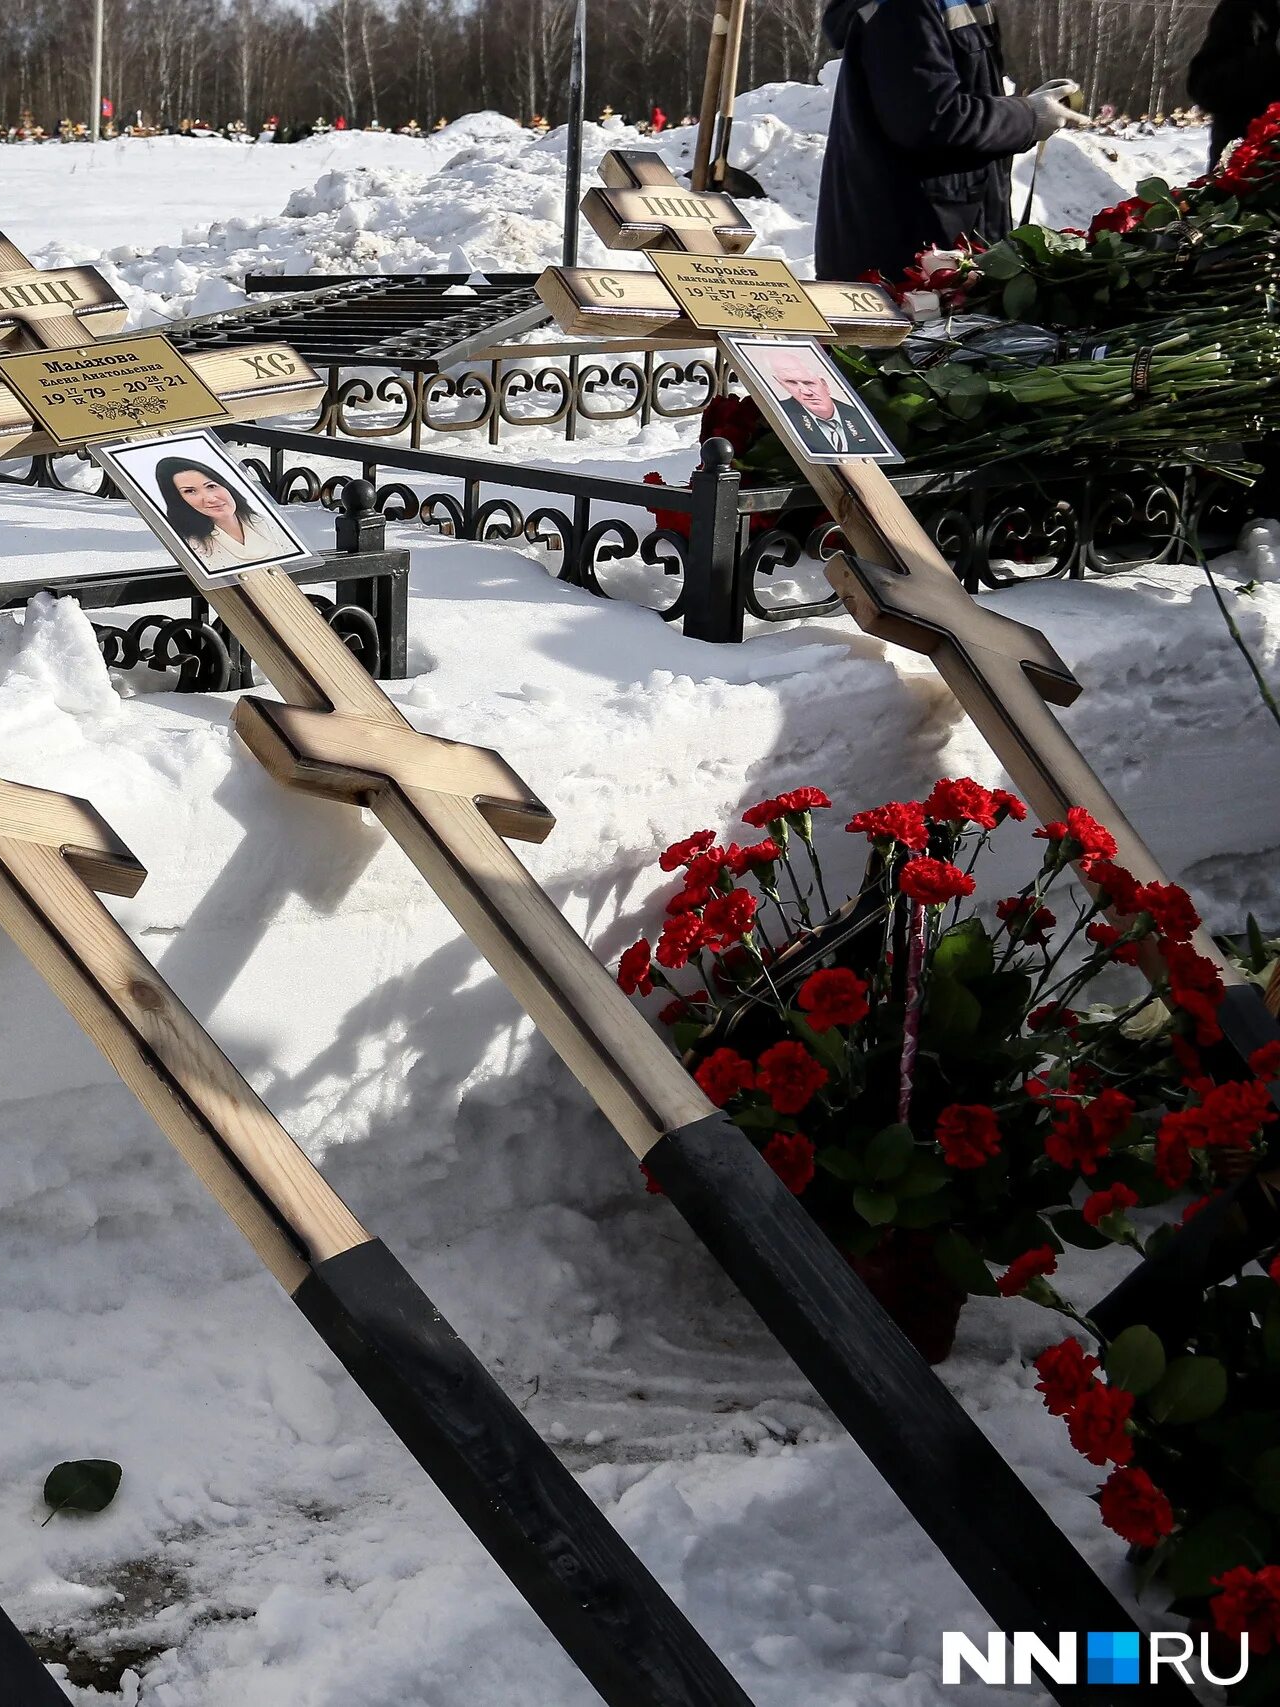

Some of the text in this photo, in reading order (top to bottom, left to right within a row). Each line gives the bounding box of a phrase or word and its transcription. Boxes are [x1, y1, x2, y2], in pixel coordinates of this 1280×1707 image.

[691, 262, 759, 277] Королёв
[677, 274, 791, 288] Анатолий Николаевич
[42, 353, 140, 374] Малахова
[38, 362, 164, 387] Елена Анатольевна
